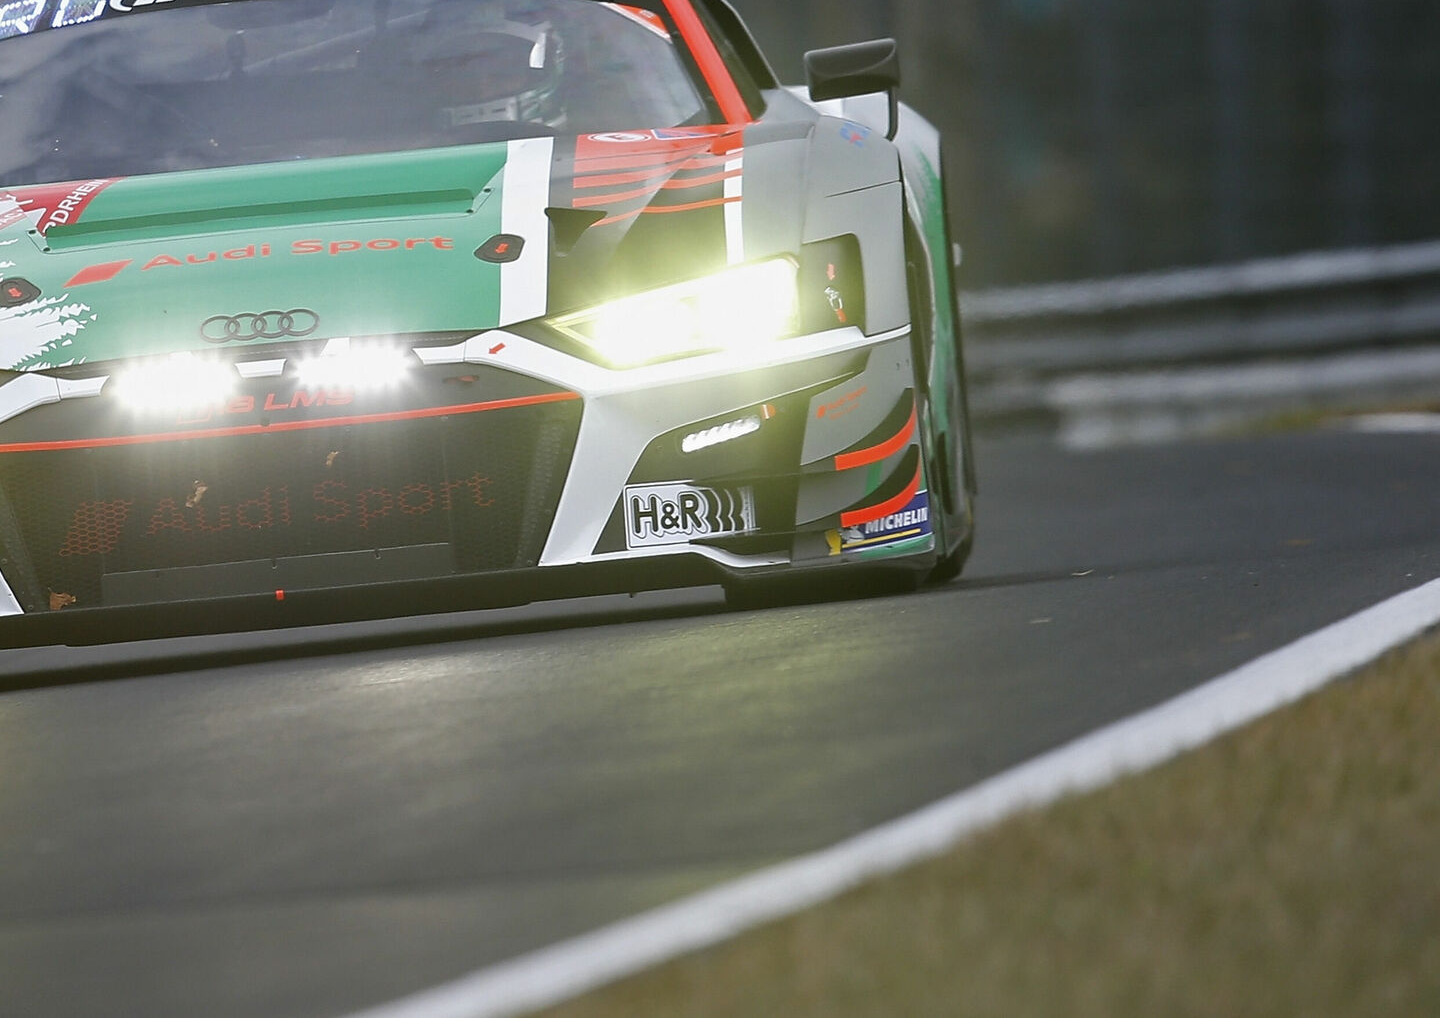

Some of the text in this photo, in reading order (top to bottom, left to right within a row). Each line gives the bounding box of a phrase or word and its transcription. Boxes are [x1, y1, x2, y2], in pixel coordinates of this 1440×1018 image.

[140, 236, 455, 271] Audi Sport
[263, 389, 353, 411] LMS
[146, 471, 496, 535] Audi Sport
[632, 493, 702, 534] H&R
[864, 507, 928, 534] MICHELIN
